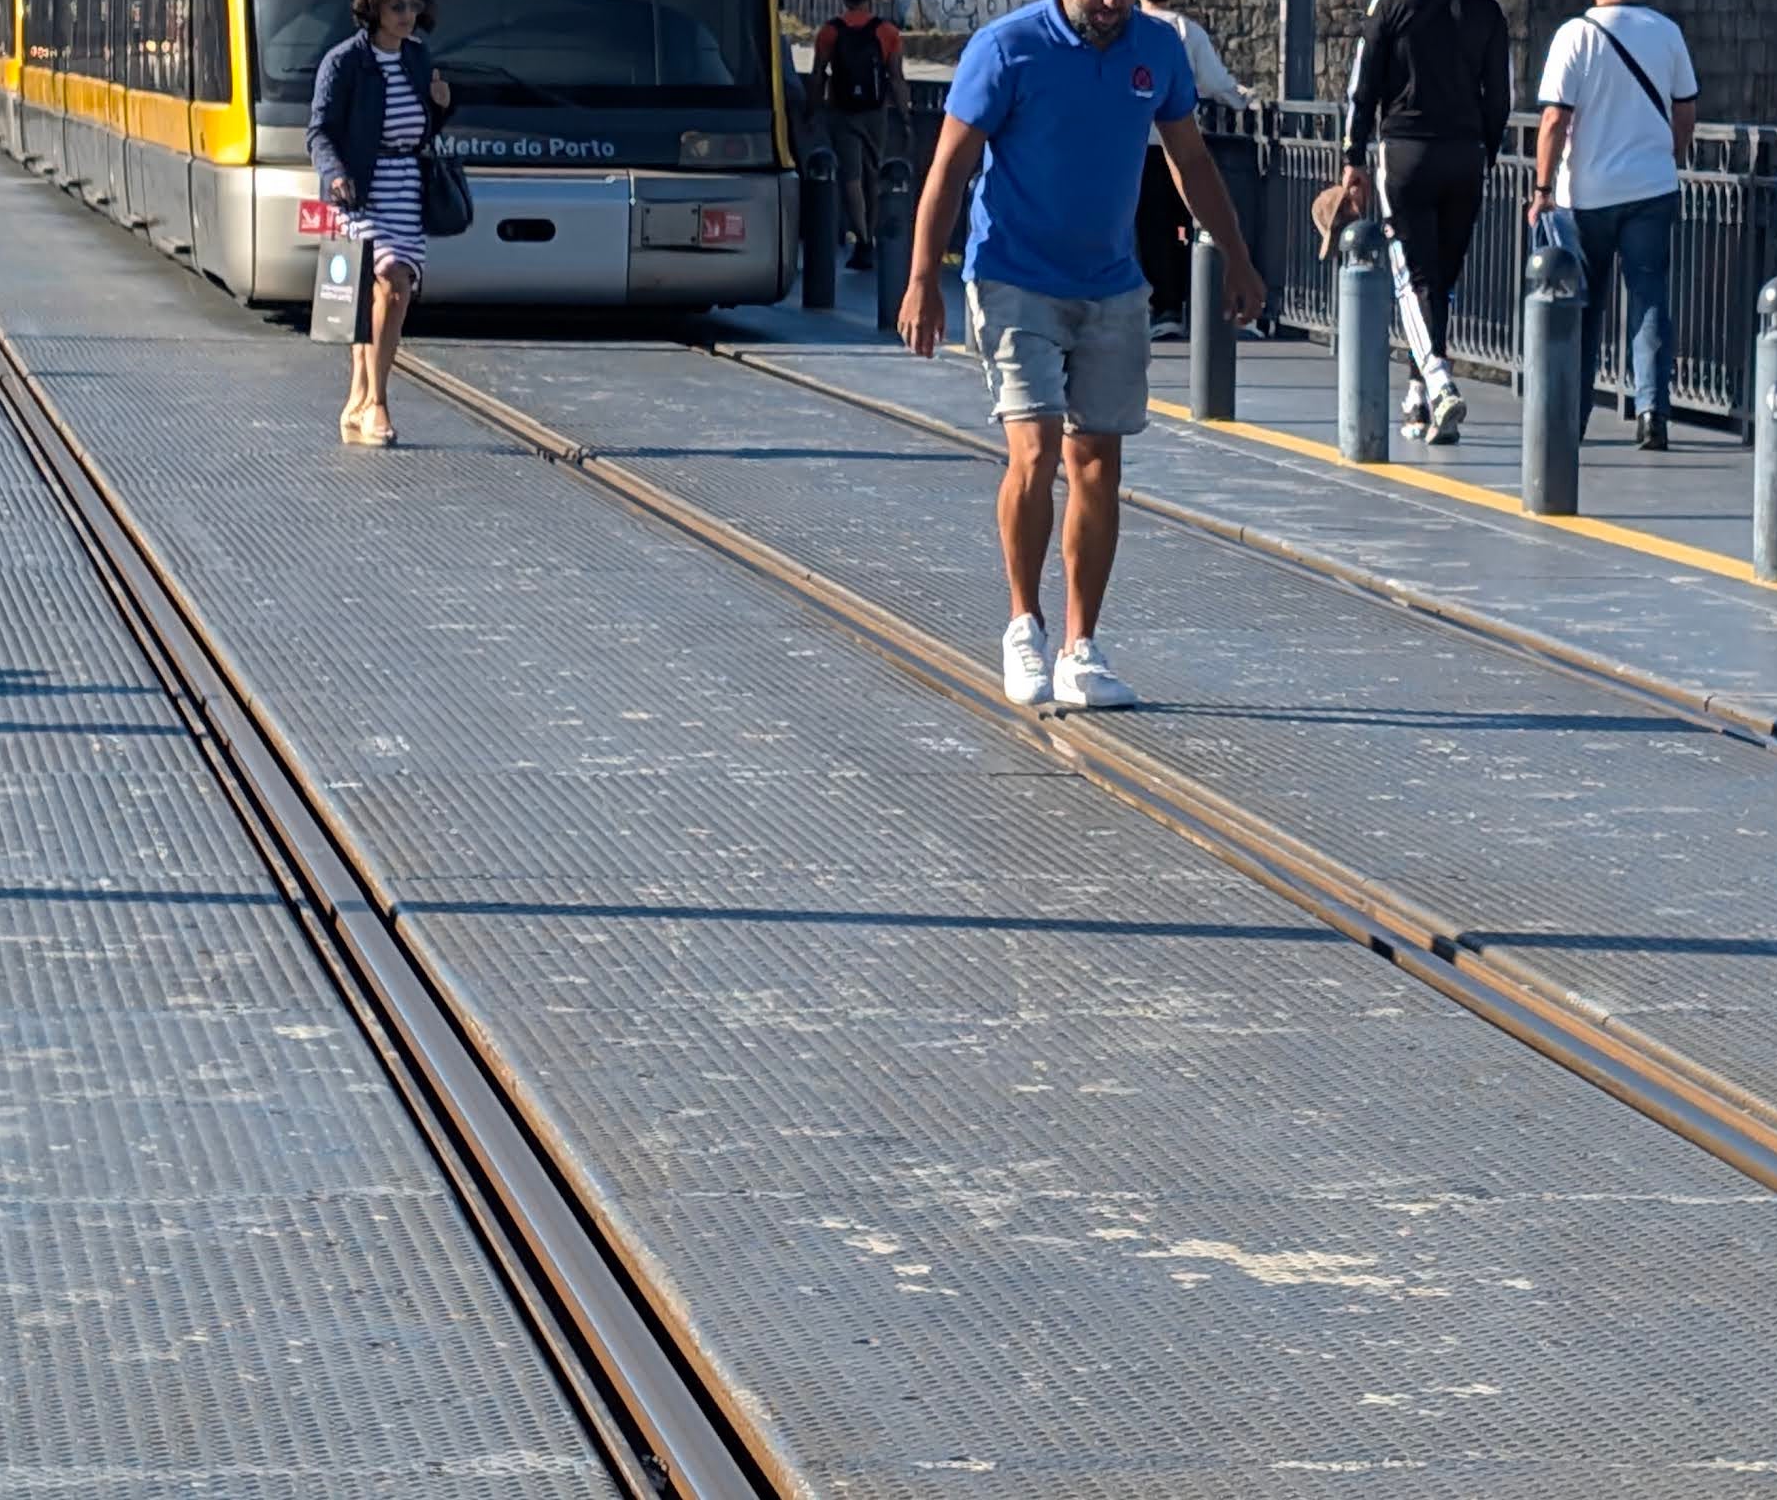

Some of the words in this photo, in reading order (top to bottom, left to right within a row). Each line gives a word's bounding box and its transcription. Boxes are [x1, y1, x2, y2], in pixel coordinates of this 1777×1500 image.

[434, 134, 506, 157] Metro
[513, 137, 542, 157] do
[549, 138, 615, 158] Porto
